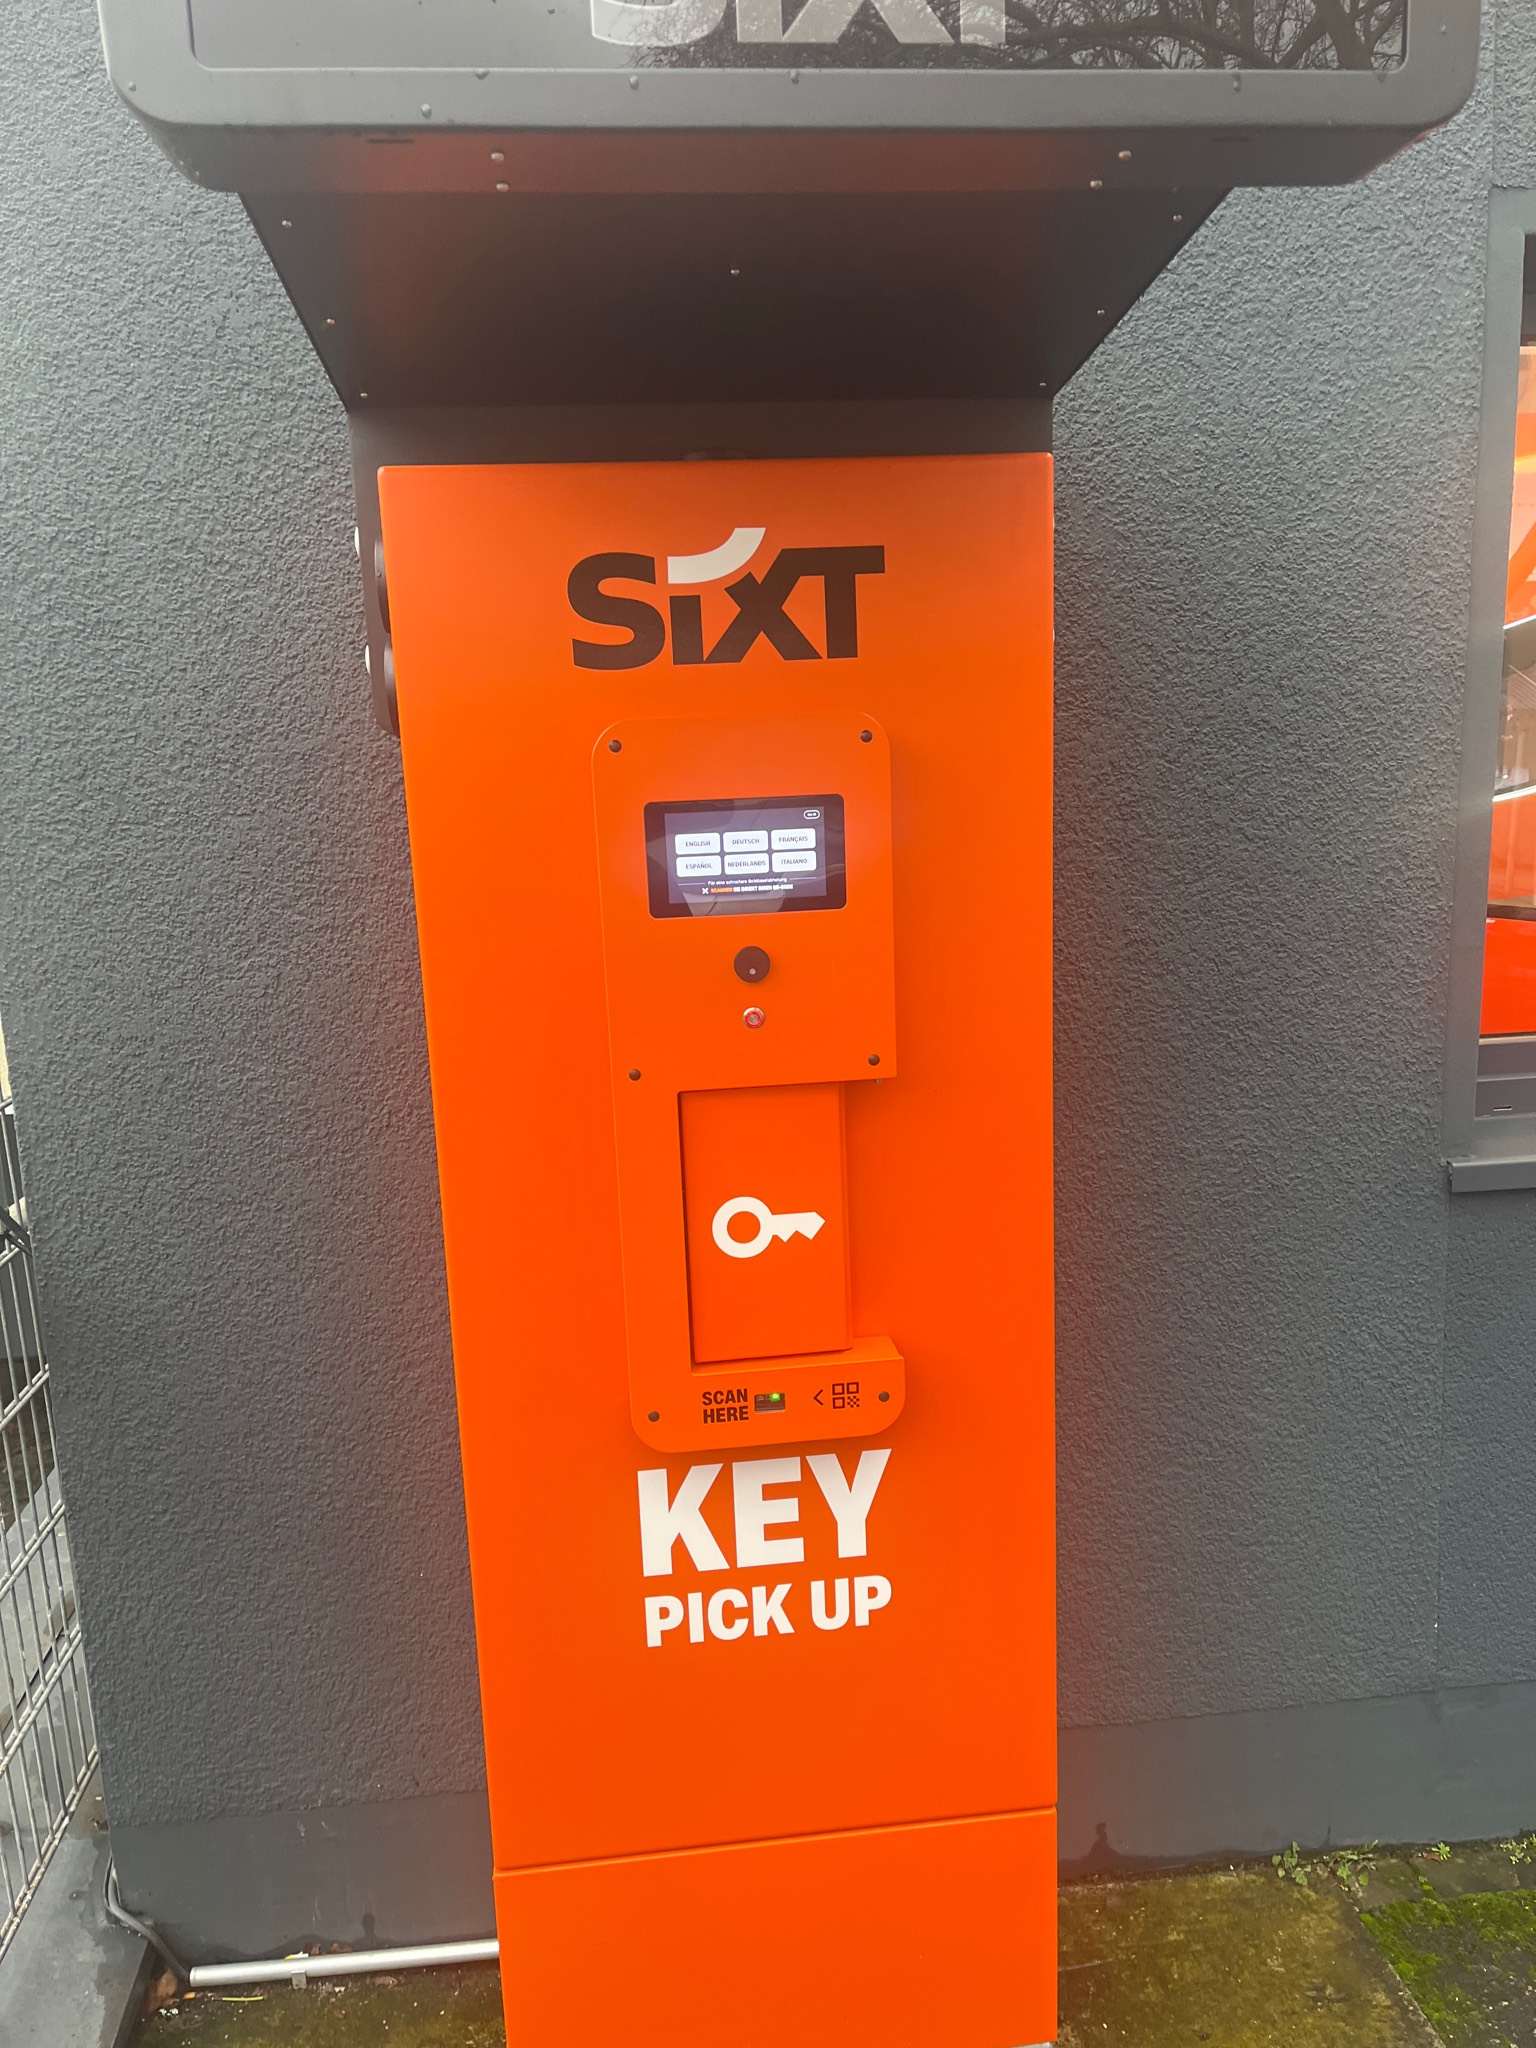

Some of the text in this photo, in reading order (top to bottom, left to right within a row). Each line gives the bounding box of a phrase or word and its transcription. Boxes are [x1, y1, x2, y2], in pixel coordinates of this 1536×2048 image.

[685, 840, 711, 848] ENGLISH
[732, 838, 760, 846] DEUTSCH
[778, 836, 809, 844] FRANÇAIS
[685, 862, 713, 870] ESPAÑOL
[727, 860, 766, 868] NEDERLANDS
[702, 1388, 748, 1406] SCAN
[703, 1405, 749, 1424] HERE
[637, 1448, 892, 1577] KEY
[644, 1574, 893, 1648] PICK UP
